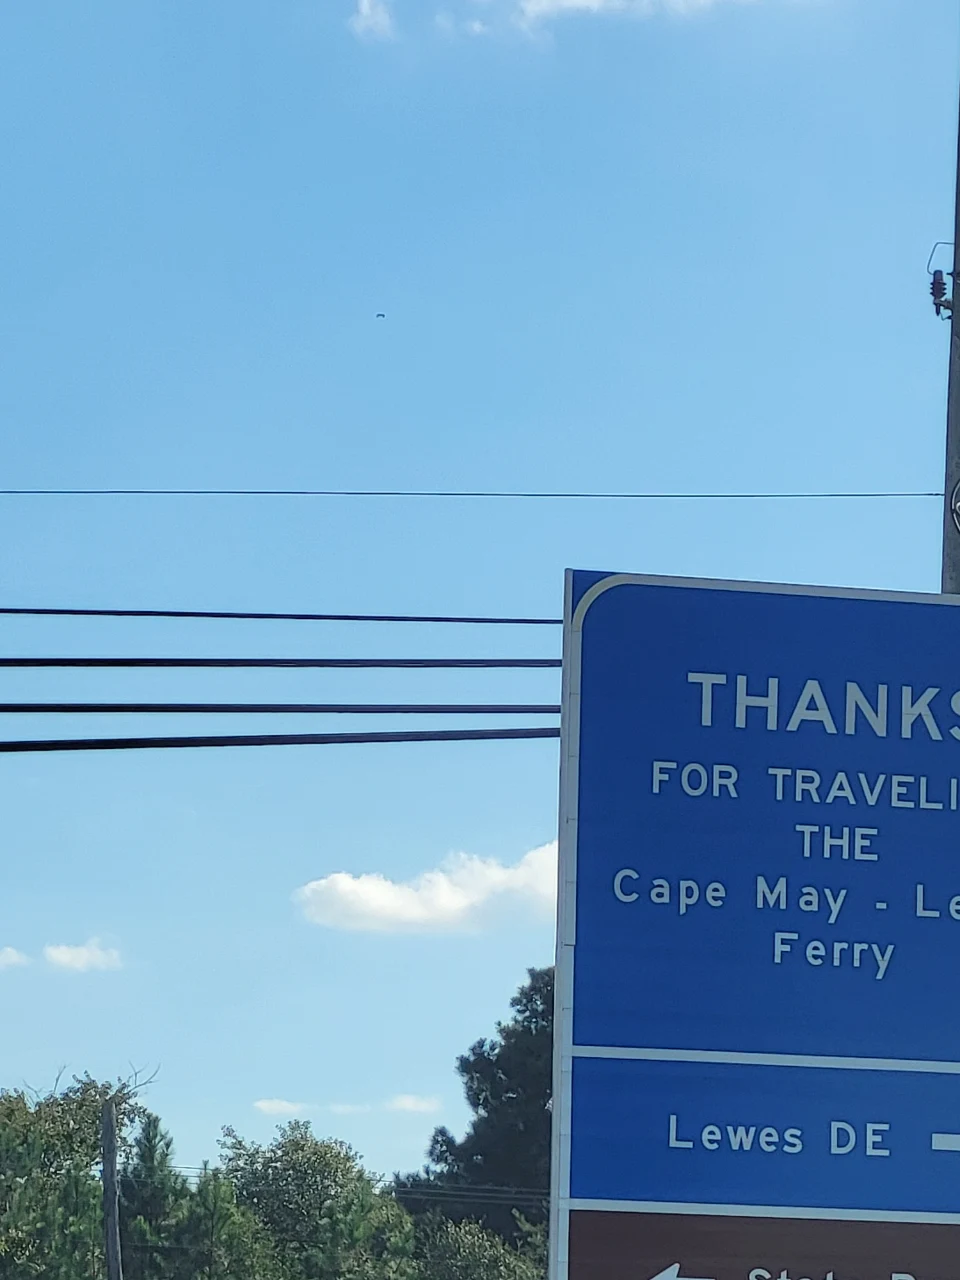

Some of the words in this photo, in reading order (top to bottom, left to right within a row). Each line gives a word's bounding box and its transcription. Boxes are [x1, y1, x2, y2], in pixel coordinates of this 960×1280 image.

[652, 761, 738, 798] FOR
[795, 824, 878, 861] THE
[613, 869, 726, 915] Cape
[756, 876, 847, 924] May
[875, 902, 887, 910] -
[774, 932, 895, 980] Ferry
[669, 1114, 803, 1154] Lewes
[830, 1121, 890, 1157] DE
